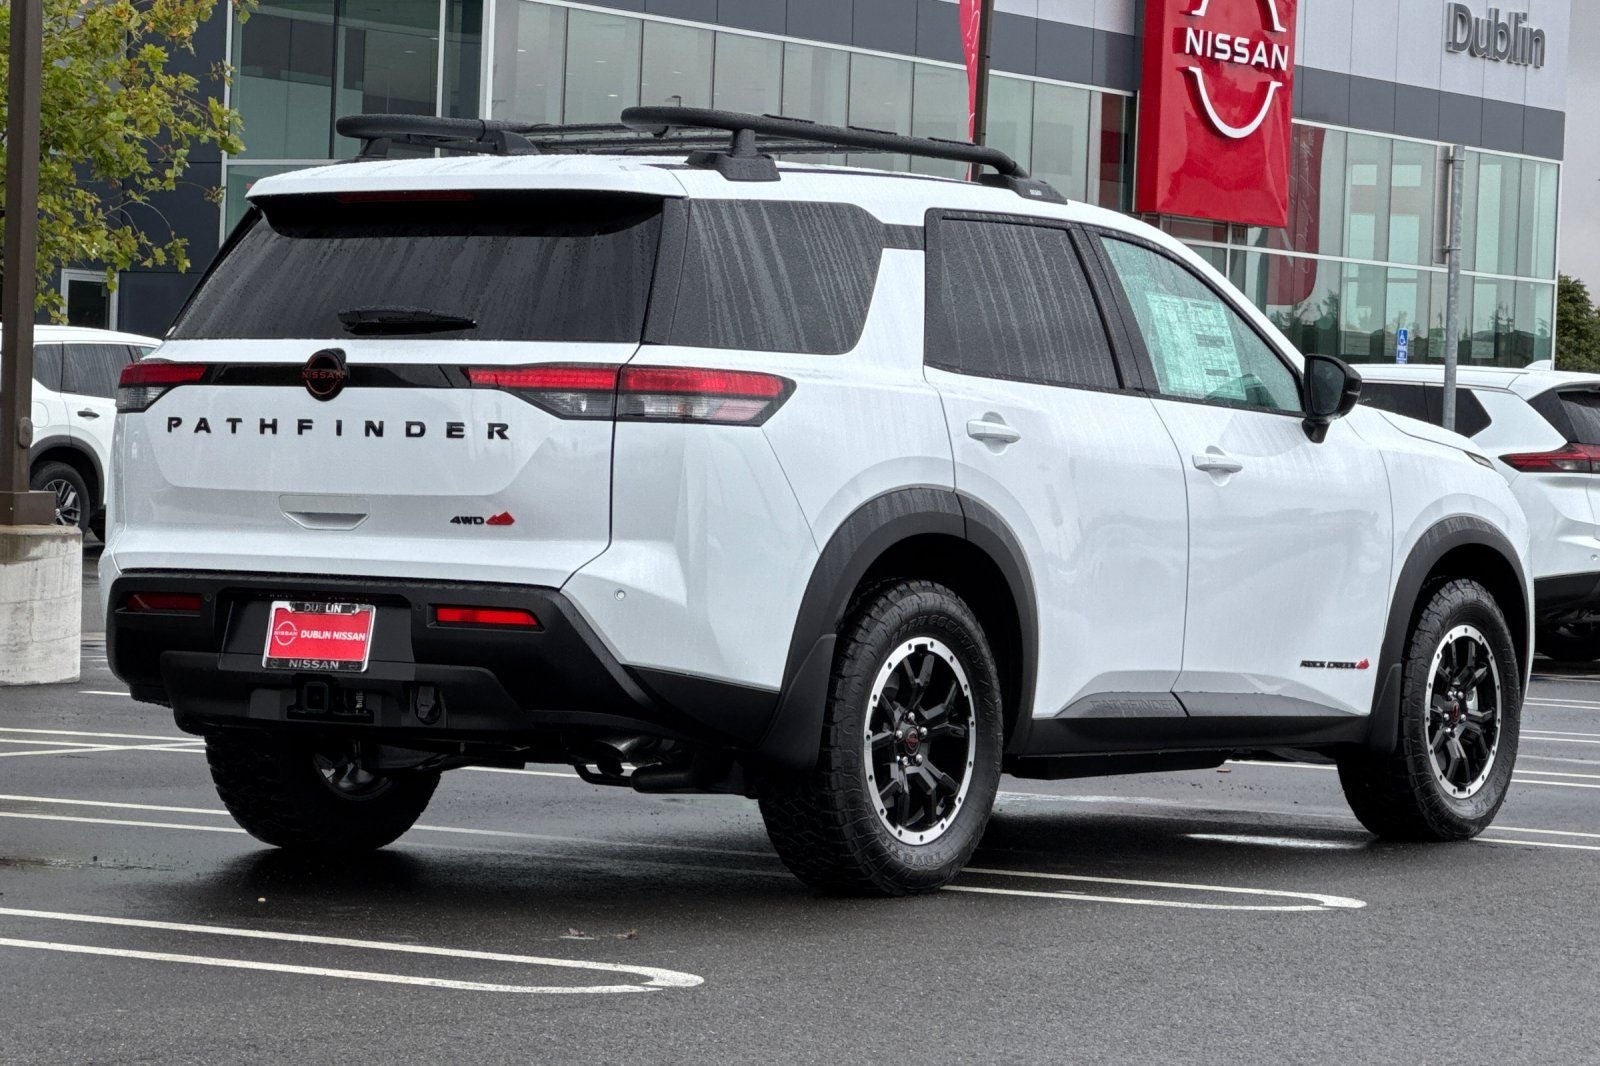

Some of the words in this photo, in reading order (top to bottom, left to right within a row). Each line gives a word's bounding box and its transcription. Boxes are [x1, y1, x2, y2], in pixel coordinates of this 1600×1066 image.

[1447, 3, 1545, 68] Dublin
[1185, 27, 1289, 71] NISSAN
[302, 370, 345, 380] NISSAN
[167, 416, 510, 440] PATHFINDER
[450, 516, 485, 525] 4WD
[300, 630, 332, 639] DUBLIN
[332, 631, 366, 641] NISSAN
[288, 659, 339, 670] NISSAN
